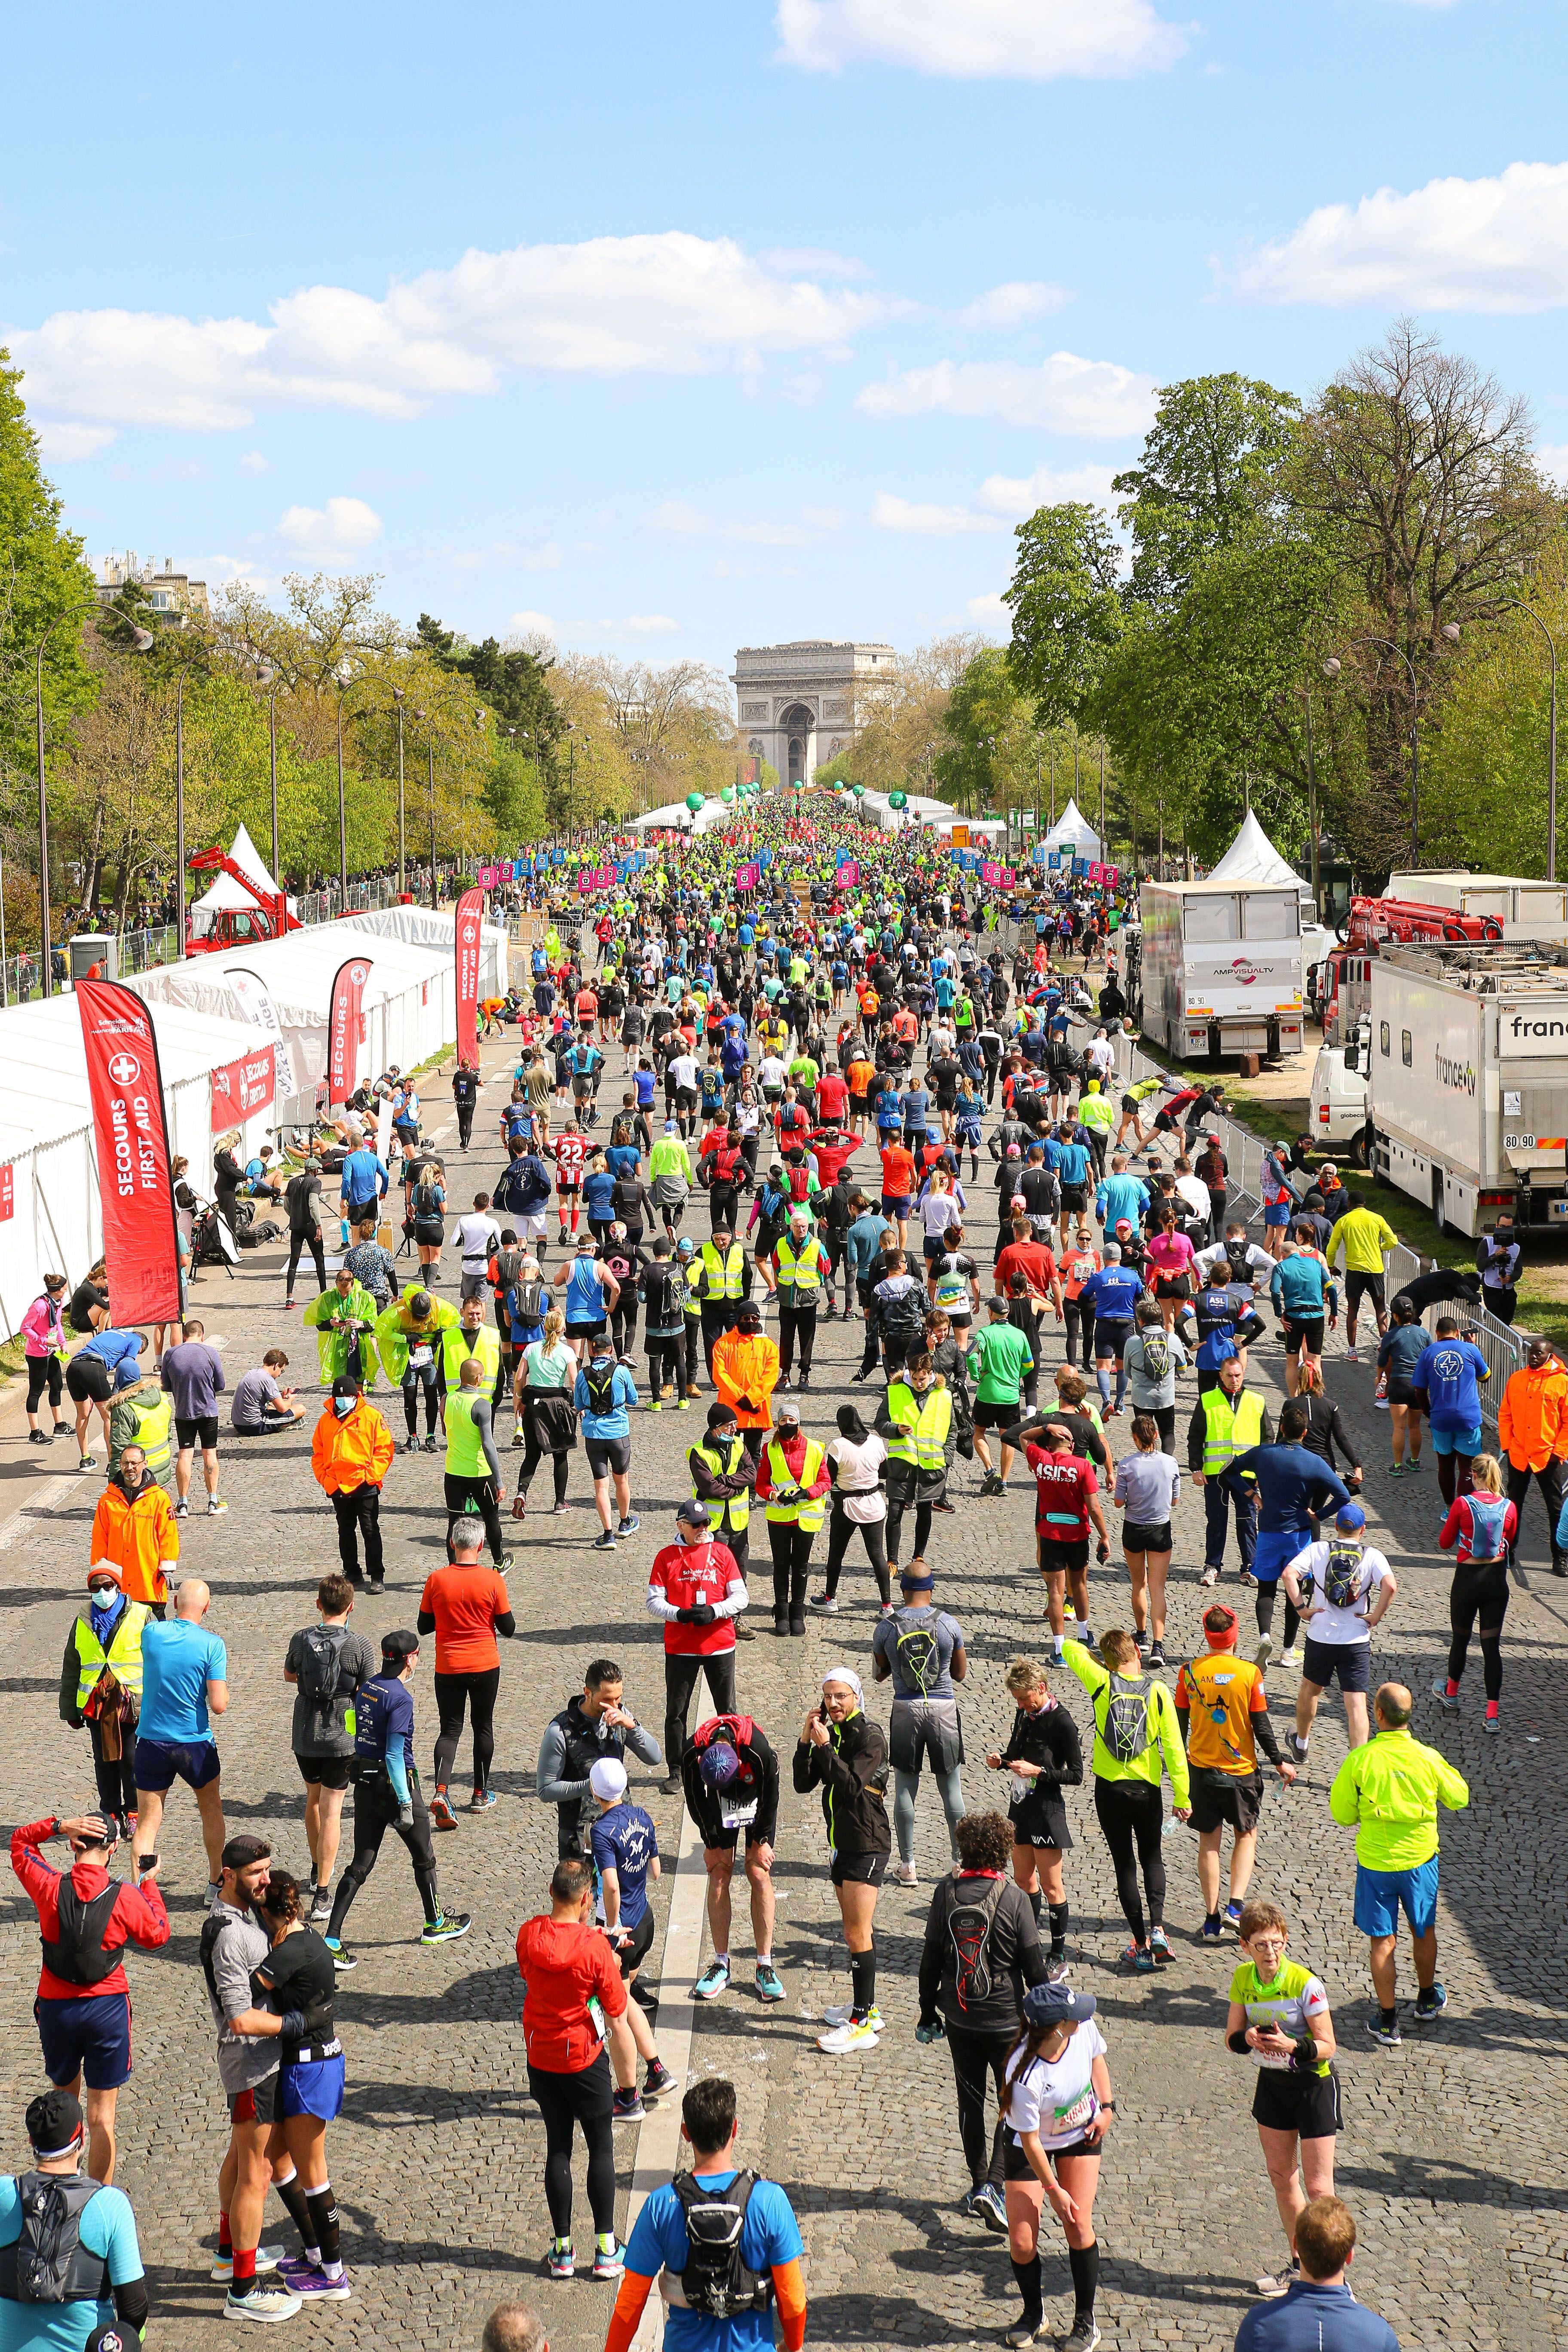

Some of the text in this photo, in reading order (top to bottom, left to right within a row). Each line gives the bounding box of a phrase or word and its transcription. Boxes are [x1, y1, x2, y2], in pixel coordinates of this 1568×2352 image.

[243, 874, 264, 895] LOXAM
[334, 996, 348, 1087] SECOURS
[245, 1057, 270, 1083] SECOURS
[110, 1099, 134, 1197] SECOURS
[134, 1096, 157, 1188] FIRST AID
[1506, 1136, 1533, 1147] 80 90
[560, 1144, 583, 1164] 22
[1035, 1463, 1078, 1480] ASICS
[1216, 1675, 1231, 1684] SAP
[622, 1850, 650, 1873] Marathon
